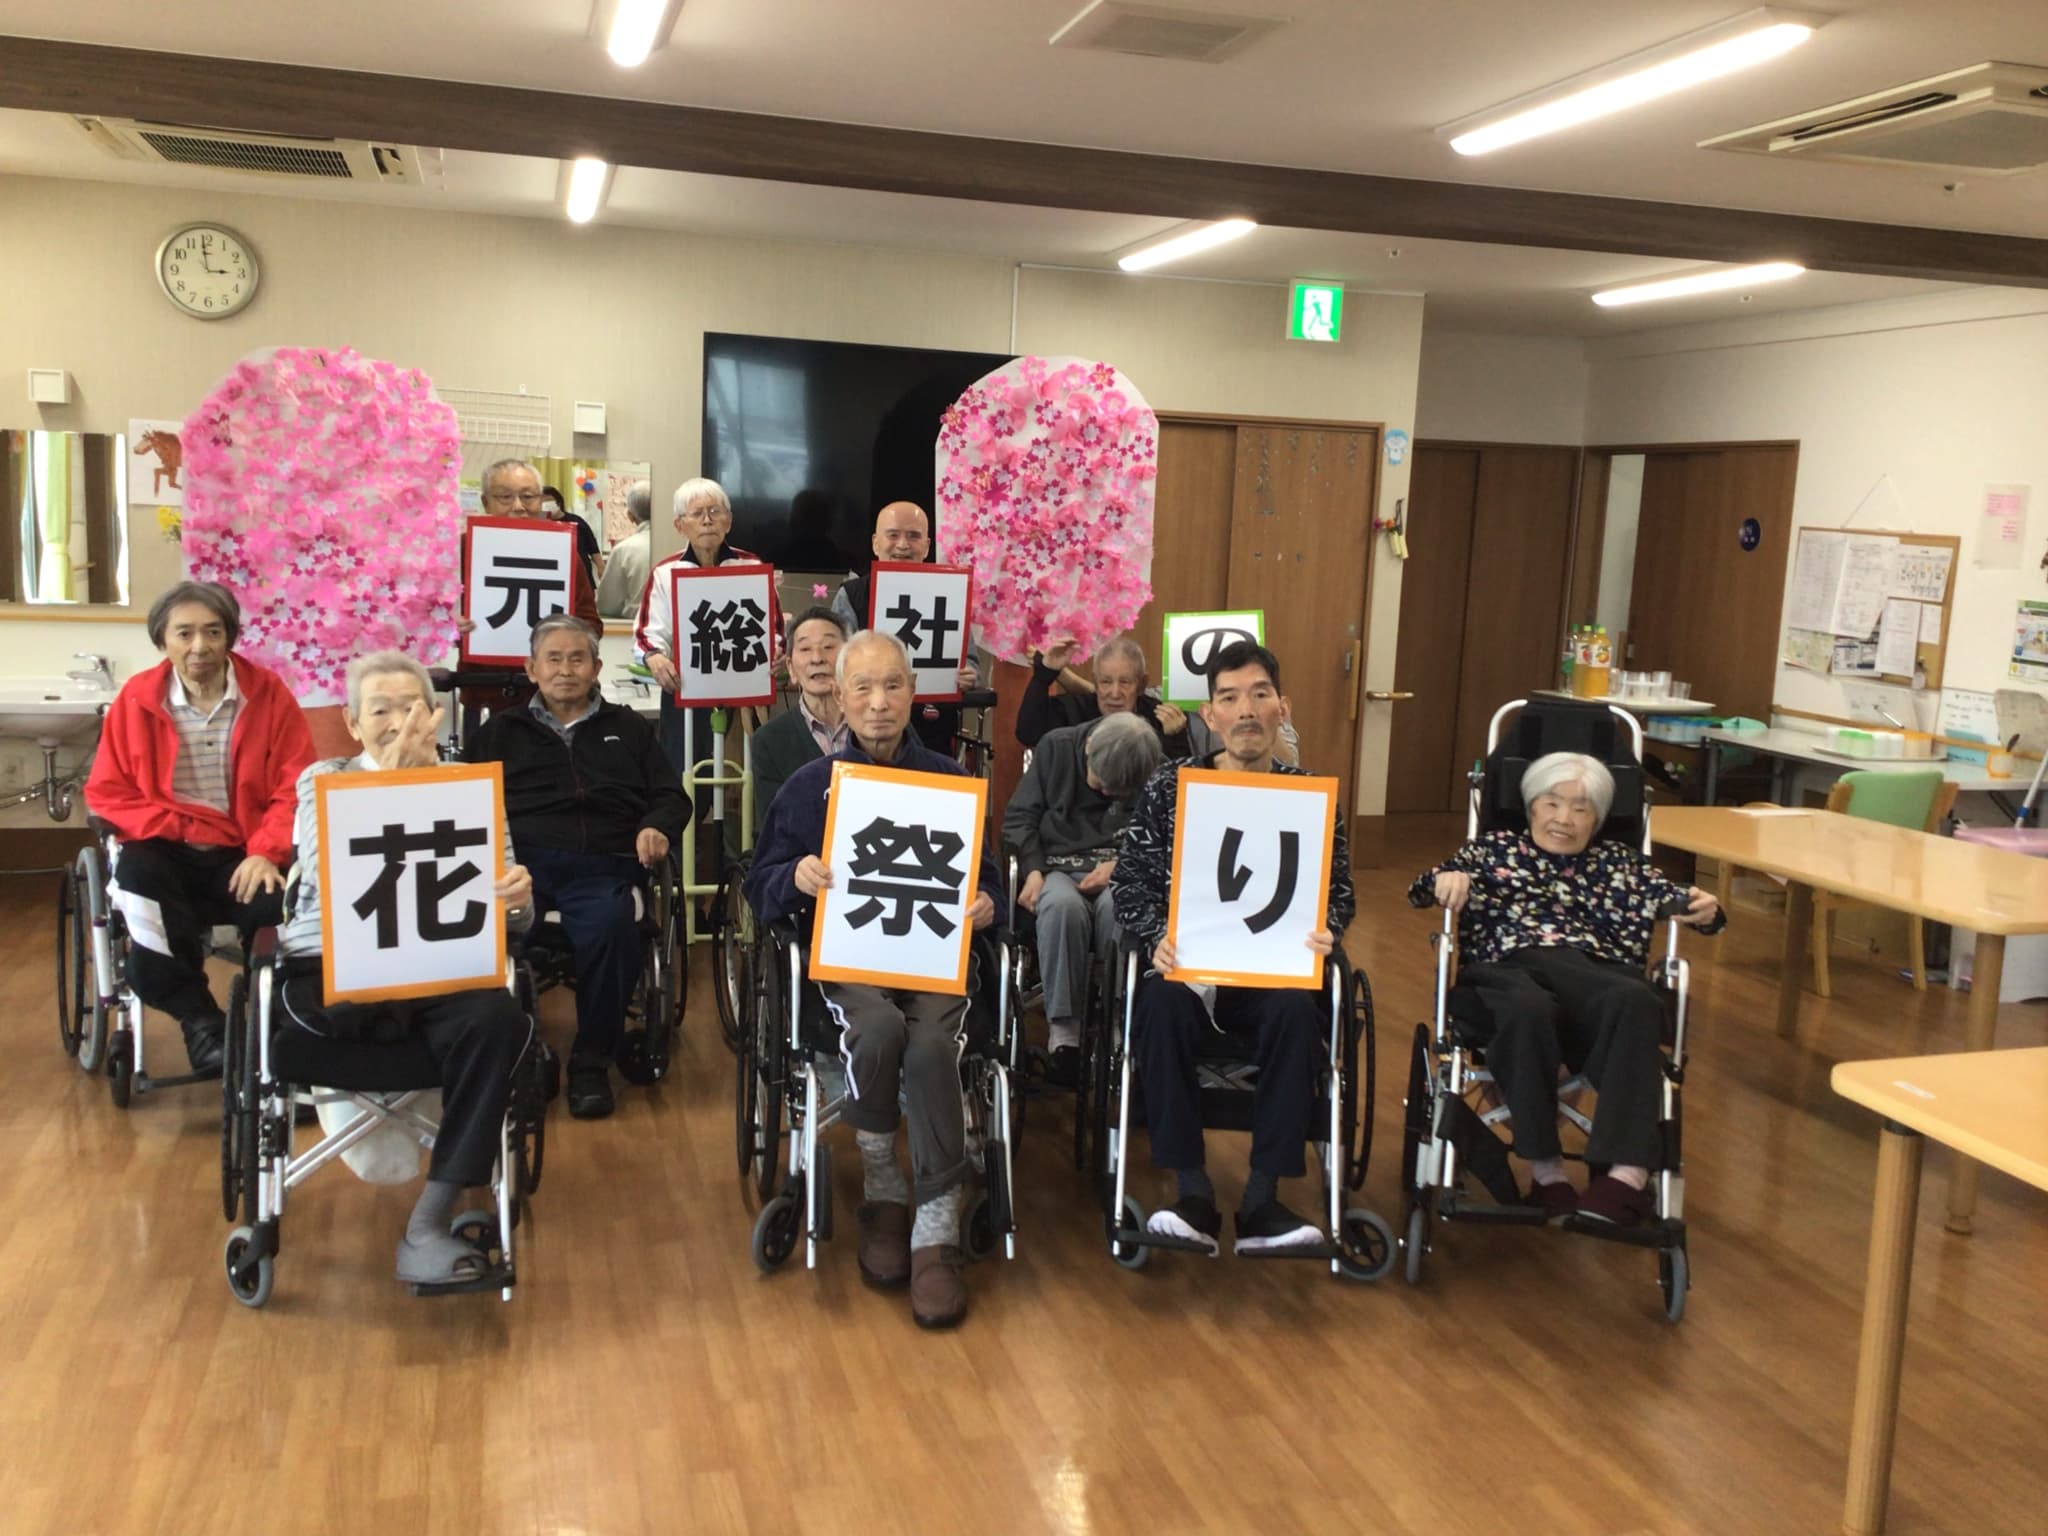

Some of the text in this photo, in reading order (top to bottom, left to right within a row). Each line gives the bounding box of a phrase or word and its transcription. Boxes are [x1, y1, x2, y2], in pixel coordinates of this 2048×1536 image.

[186, 238, 196, 249] 11
[222, 239, 226, 251] 1
[175, 248, 187, 260] 10
[232, 252, 240, 264] 2
[170, 264, 179, 275] 9
[238, 268, 246, 279] 3
[177, 280, 185, 291] 8
[231, 283, 239, 294] 4
[189, 292, 197, 303] 7
[203, 296, 213, 308] 6
[221, 294, 229, 305] 5
[484, 556, 565, 630] 元
[689, 599, 769, 674] 総
[885, 594, 960, 669] 社
[1182, 628, 1258, 676] の
[843, 816, 967, 939] 祭
[1217, 826, 1300, 934] り
[349, 820, 489, 949] 花
